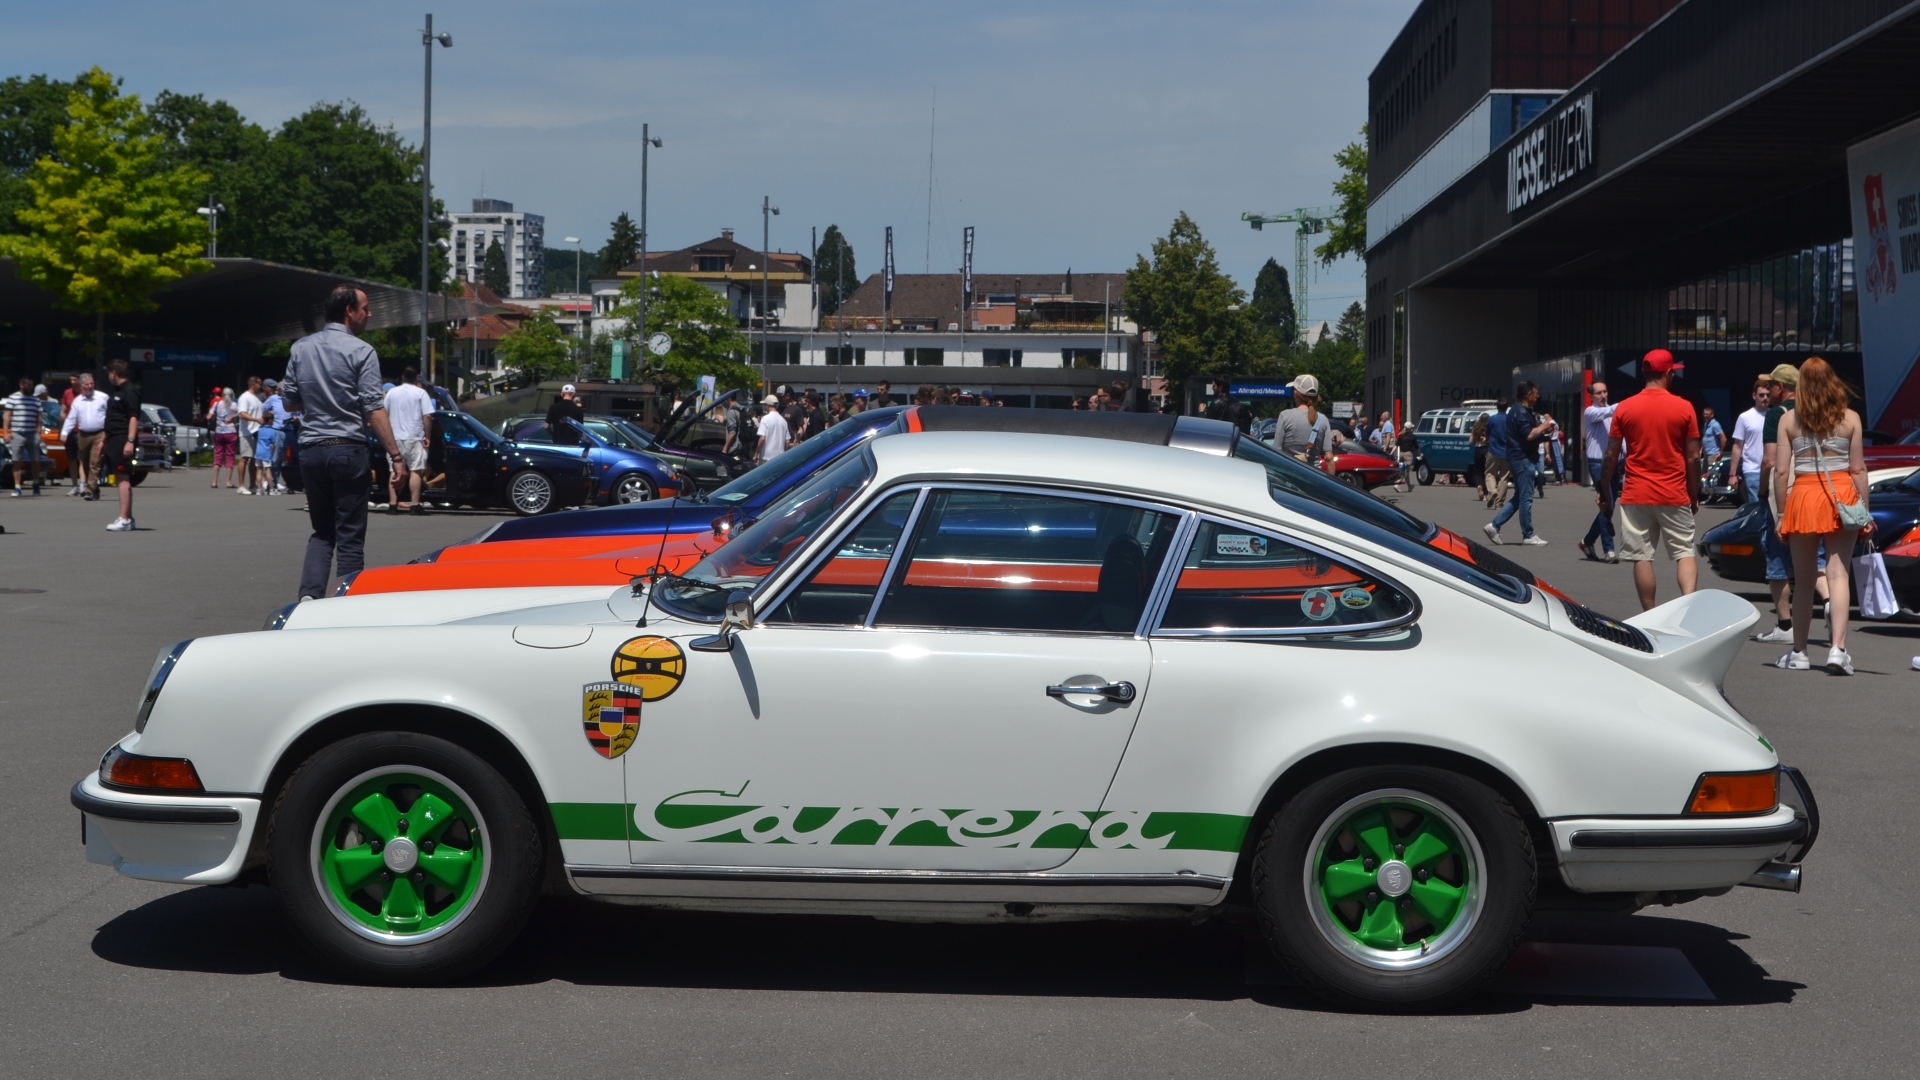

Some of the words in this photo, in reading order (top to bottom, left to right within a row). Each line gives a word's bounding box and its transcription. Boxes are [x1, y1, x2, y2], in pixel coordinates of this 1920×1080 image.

[1508, 91, 1593, 214] MESSELUZERN
[1897, 193, 1918, 230] SWISS
[1899, 231, 1920, 274] WOR
[1238, 387, 1286, 395] Allmend/Messe
[1440, 387, 1501, 401] FORUM
[585, 683, 641, 696] PORSCHE
[633, 779, 1178, 850] Carrera
